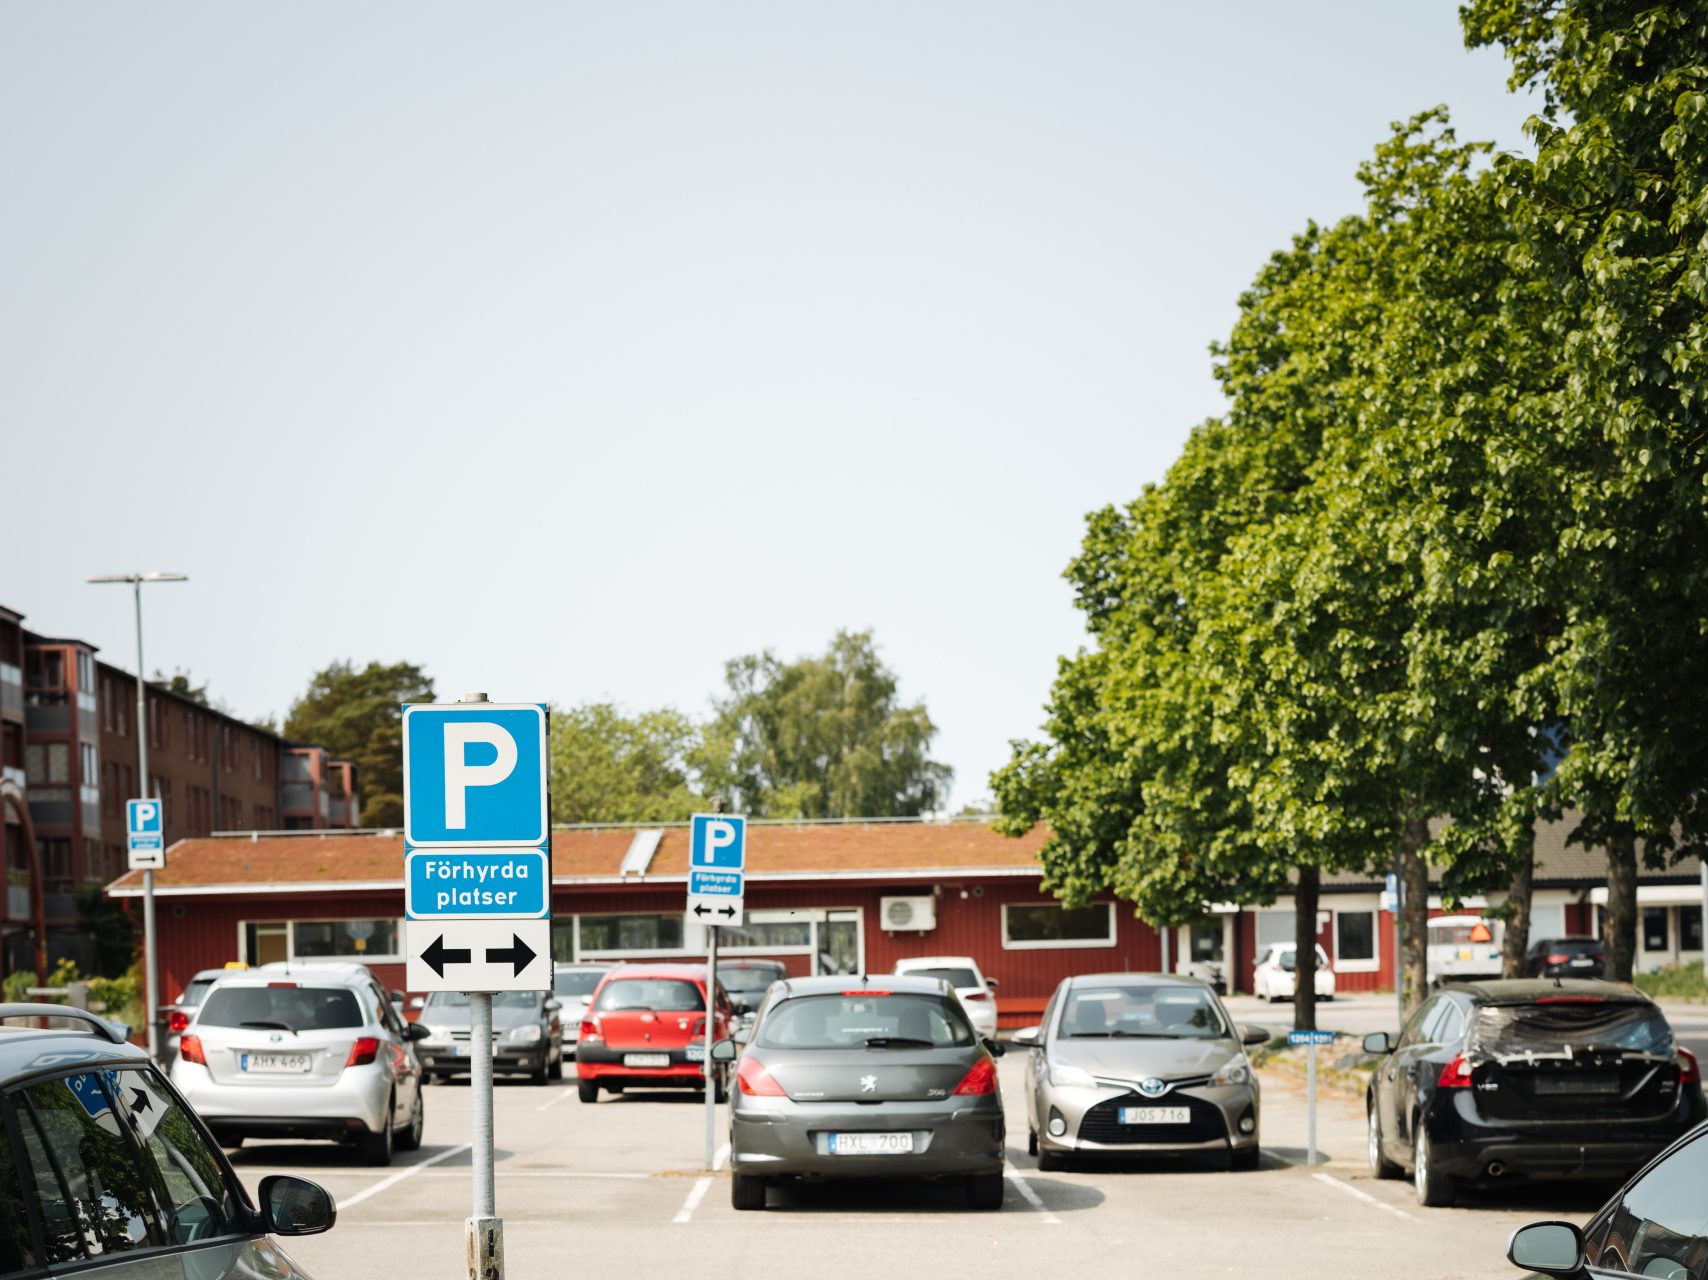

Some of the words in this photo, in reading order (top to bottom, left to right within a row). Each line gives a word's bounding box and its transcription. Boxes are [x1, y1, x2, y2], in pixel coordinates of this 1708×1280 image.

[443, 722, 518, 830] P
[136, 803, 156, 831] P
[704, 820, 736, 864] P
[425, 860, 529, 883] Förhyrda
[436, 887, 518, 910] platser
[252, 1054, 277, 1068] AHX
[280, 1054, 305, 1068] 469
[1131, 1109, 1155, 1121] JOS
[1160, 1109, 1185, 1121] 716
[839, 1135, 867, 1150] HXL
[879, 1135, 909, 1150] 700
